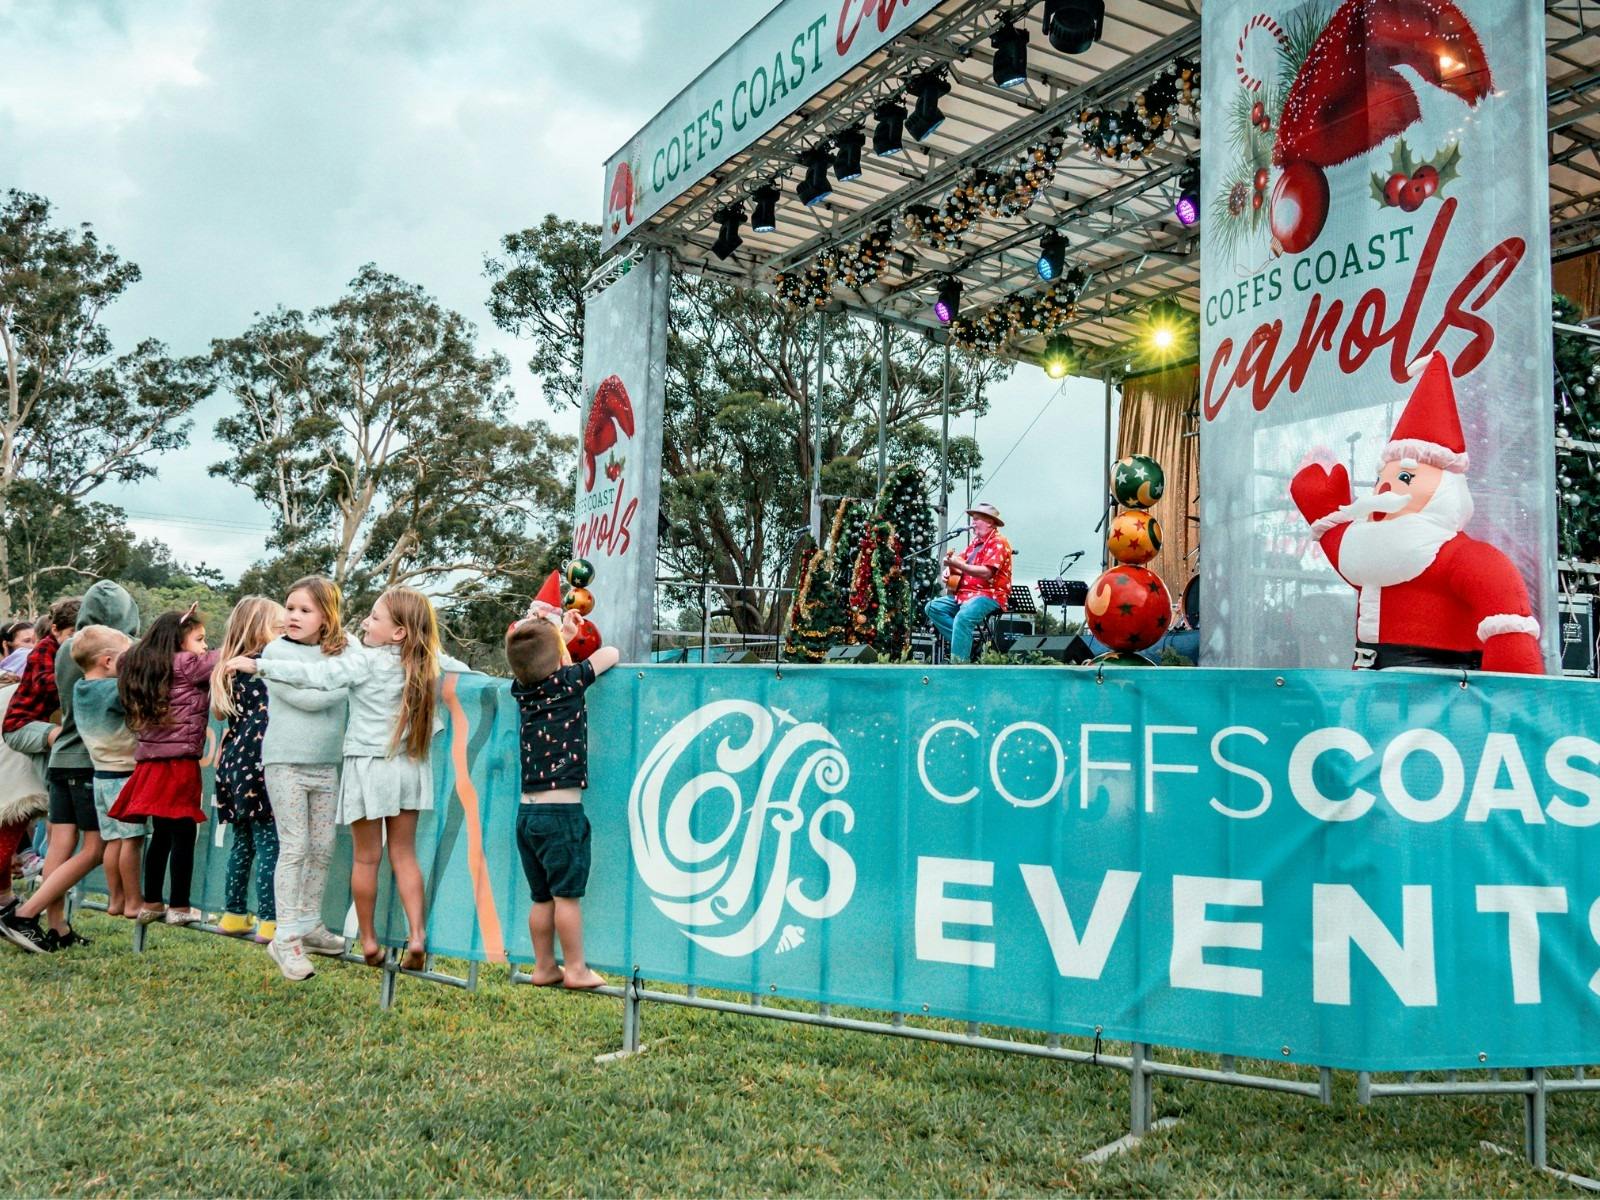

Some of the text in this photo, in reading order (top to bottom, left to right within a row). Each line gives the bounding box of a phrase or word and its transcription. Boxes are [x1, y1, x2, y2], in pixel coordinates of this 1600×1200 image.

[652, 99, 724, 193] COFFS
[731, 13, 827, 132] COAST
[1203, 197, 1526, 422] carols
[1205, 226, 1414, 327] COFFS COAST
[588, 488, 615, 511] COAST
[915, 855, 1600, 1007] EVENT
